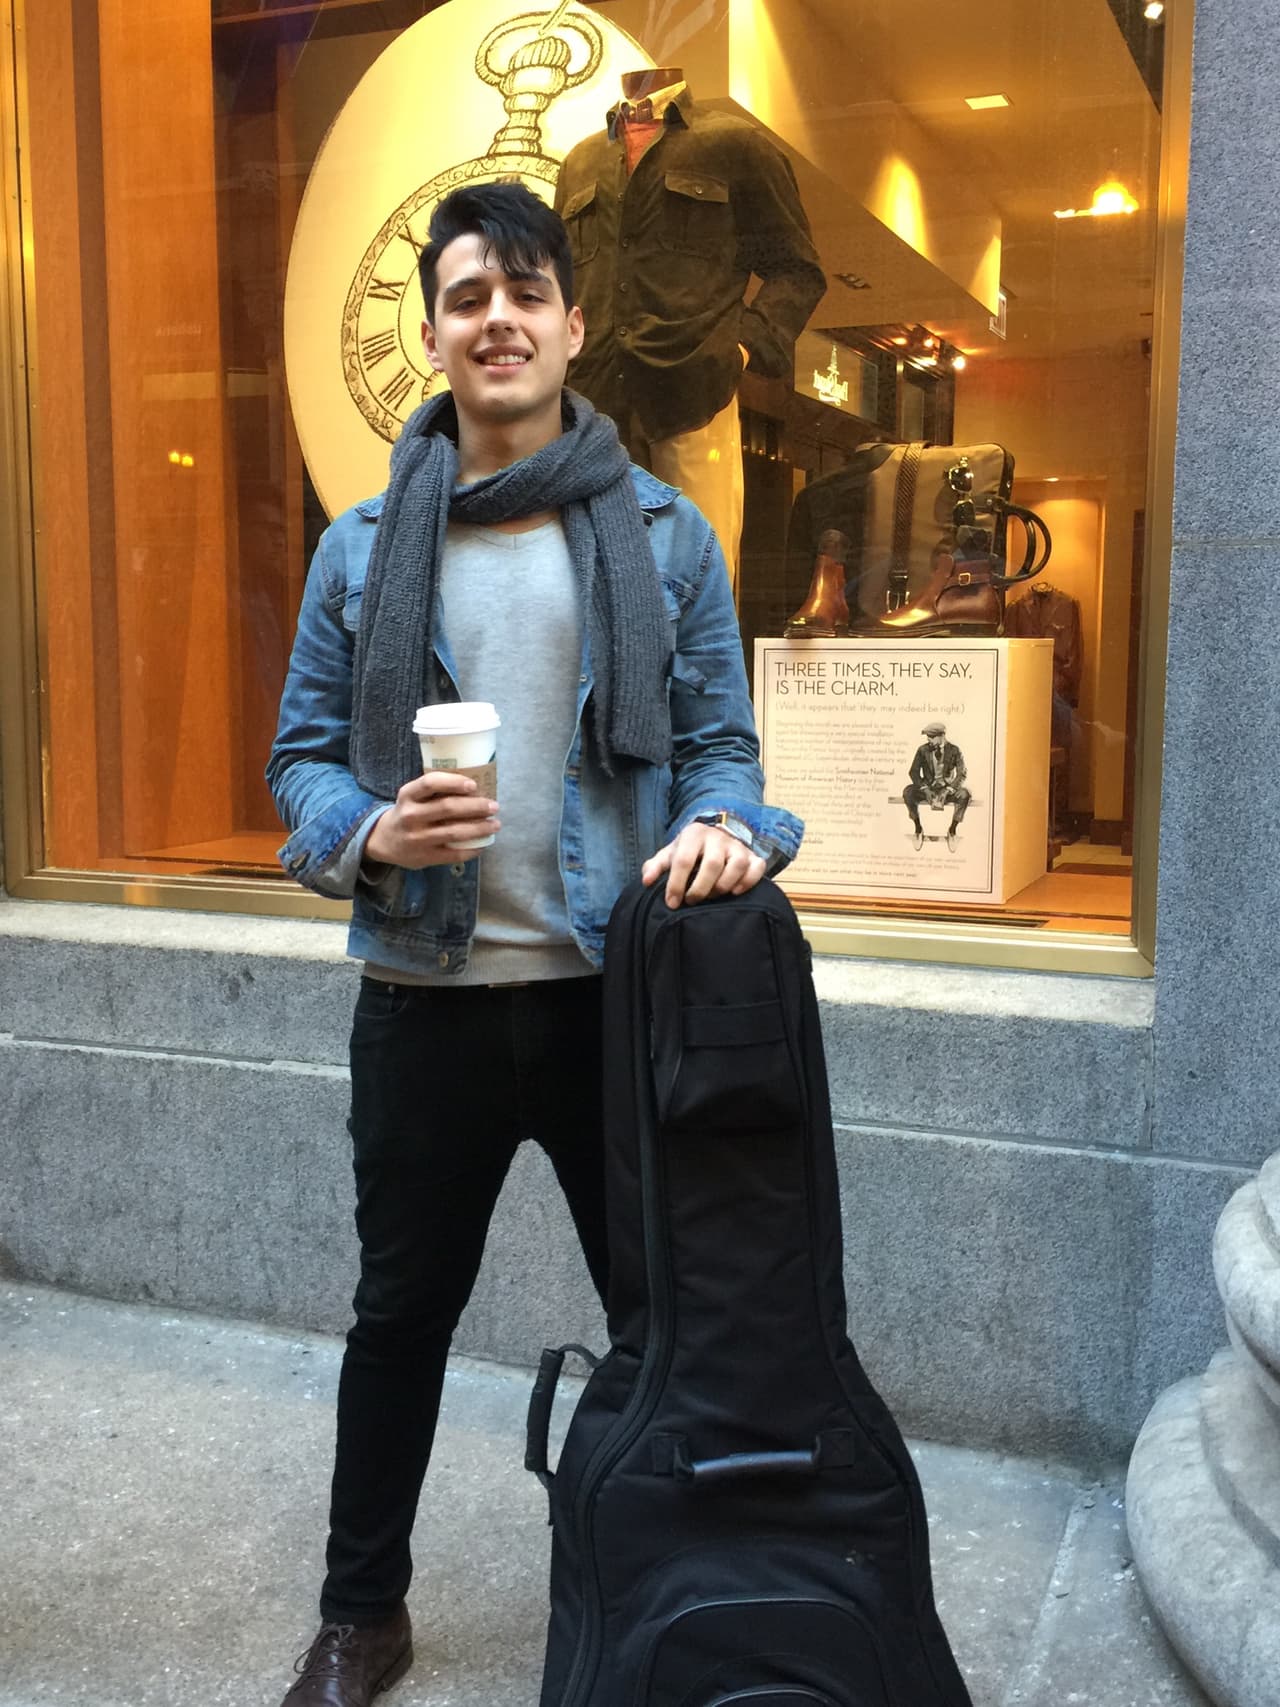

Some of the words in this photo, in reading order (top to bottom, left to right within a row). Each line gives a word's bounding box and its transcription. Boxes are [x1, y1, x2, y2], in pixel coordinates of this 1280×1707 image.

[774, 662, 827, 678] THREE
[831, 662, 885, 678] TIMES,
[888, 662, 934, 678] THEY
[938, 663, 973, 680] SAY,
[775, 680, 790, 695] IS
[794, 680, 826, 696] THE
[831, 680, 899, 697] CHARM.
[808, 703, 840, 713] appears
[840, 703, 857, 712] that
[880, 706, 897, 714] may
[927, 704, 939, 714] be
